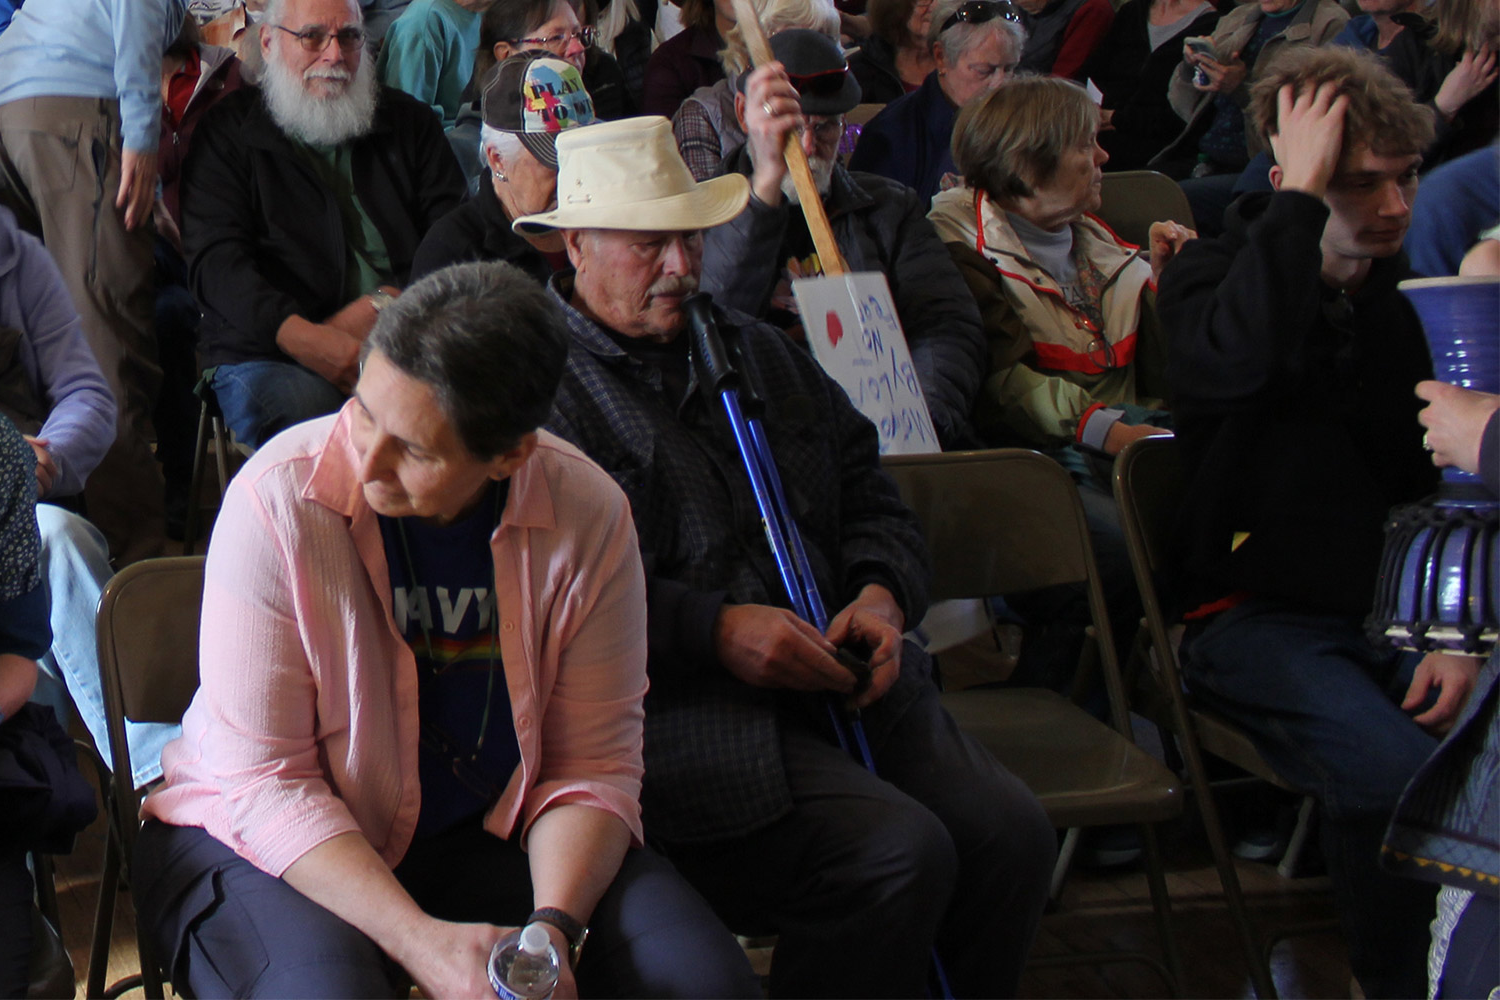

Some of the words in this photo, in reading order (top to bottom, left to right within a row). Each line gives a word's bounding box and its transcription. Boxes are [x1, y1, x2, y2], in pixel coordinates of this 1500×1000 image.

[531, 78, 579, 99] PLAY
[537, 104, 568, 122] TO
[573, 98, 592, 115] WI
